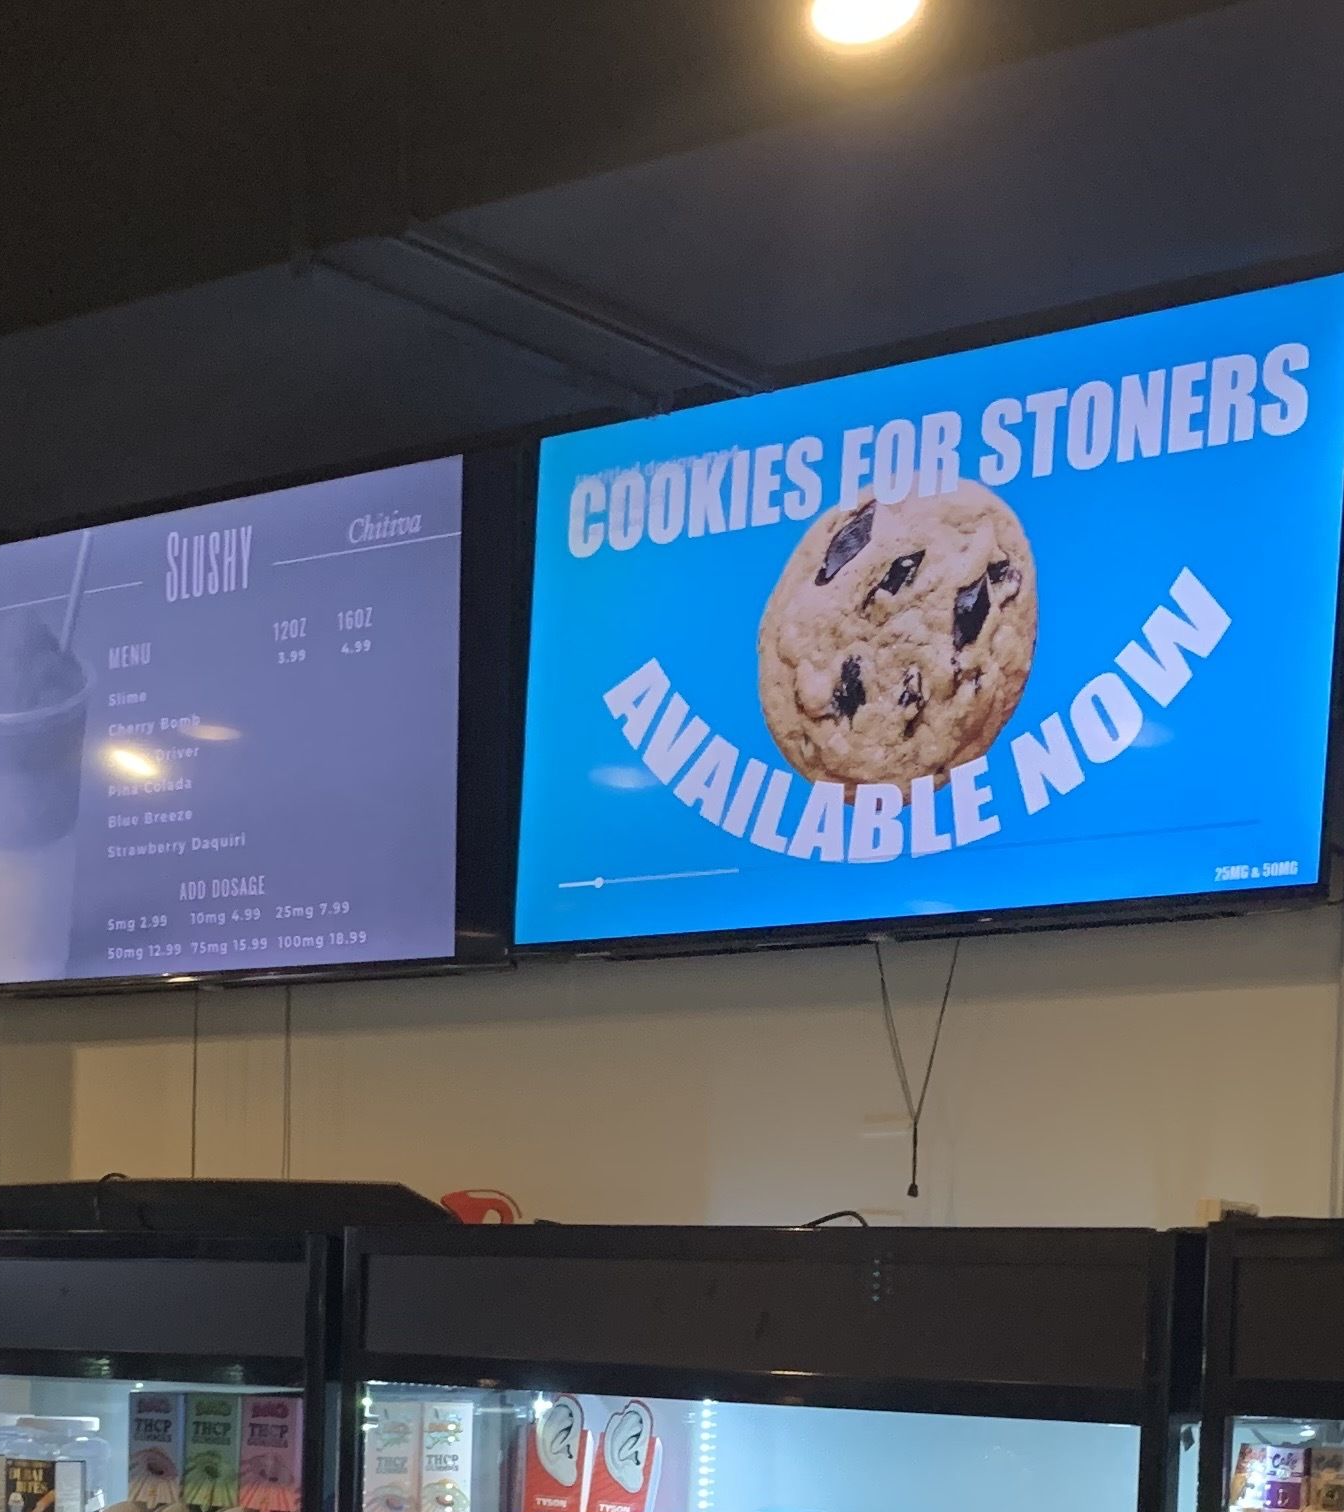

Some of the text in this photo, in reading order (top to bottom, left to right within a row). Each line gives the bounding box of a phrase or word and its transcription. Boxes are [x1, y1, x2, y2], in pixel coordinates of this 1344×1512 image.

[568, 341, 1312, 559] COOKIES FOR STONERS
[347, 510, 422, 545] Chitiva
[165, 525, 254, 602] SLUSHY
[107, 642, 152, 671] MENU
[277, 639, 372, 665] 3.99 4.99
[107, 689, 148, 707] Slime
[601, 566, 1233, 865] AVAILABLE NOW
[107, 720, 155, 738] Cherry
[144, 777, 193, 794] Colada
[108, 809, 193, 829] Blue Breeze
[107, 832, 246, 858] Strawberry Daquiri
[1214, 865, 1249, 881] 25MG
[1263, 861, 1299, 877] 50MG
[179, 875, 266, 902] ADD DOSAGE
[189, 907, 261, 928] 10mg 4.99
[274, 900, 351, 922] 25mg 7.99
[107, 913, 168, 933] 5mg 2.99
[190, 936, 268, 957] 75mg 15.99
[277, 930, 368, 951] 100mg 18.99
[106, 942, 182, 962] 50mg 12.99
